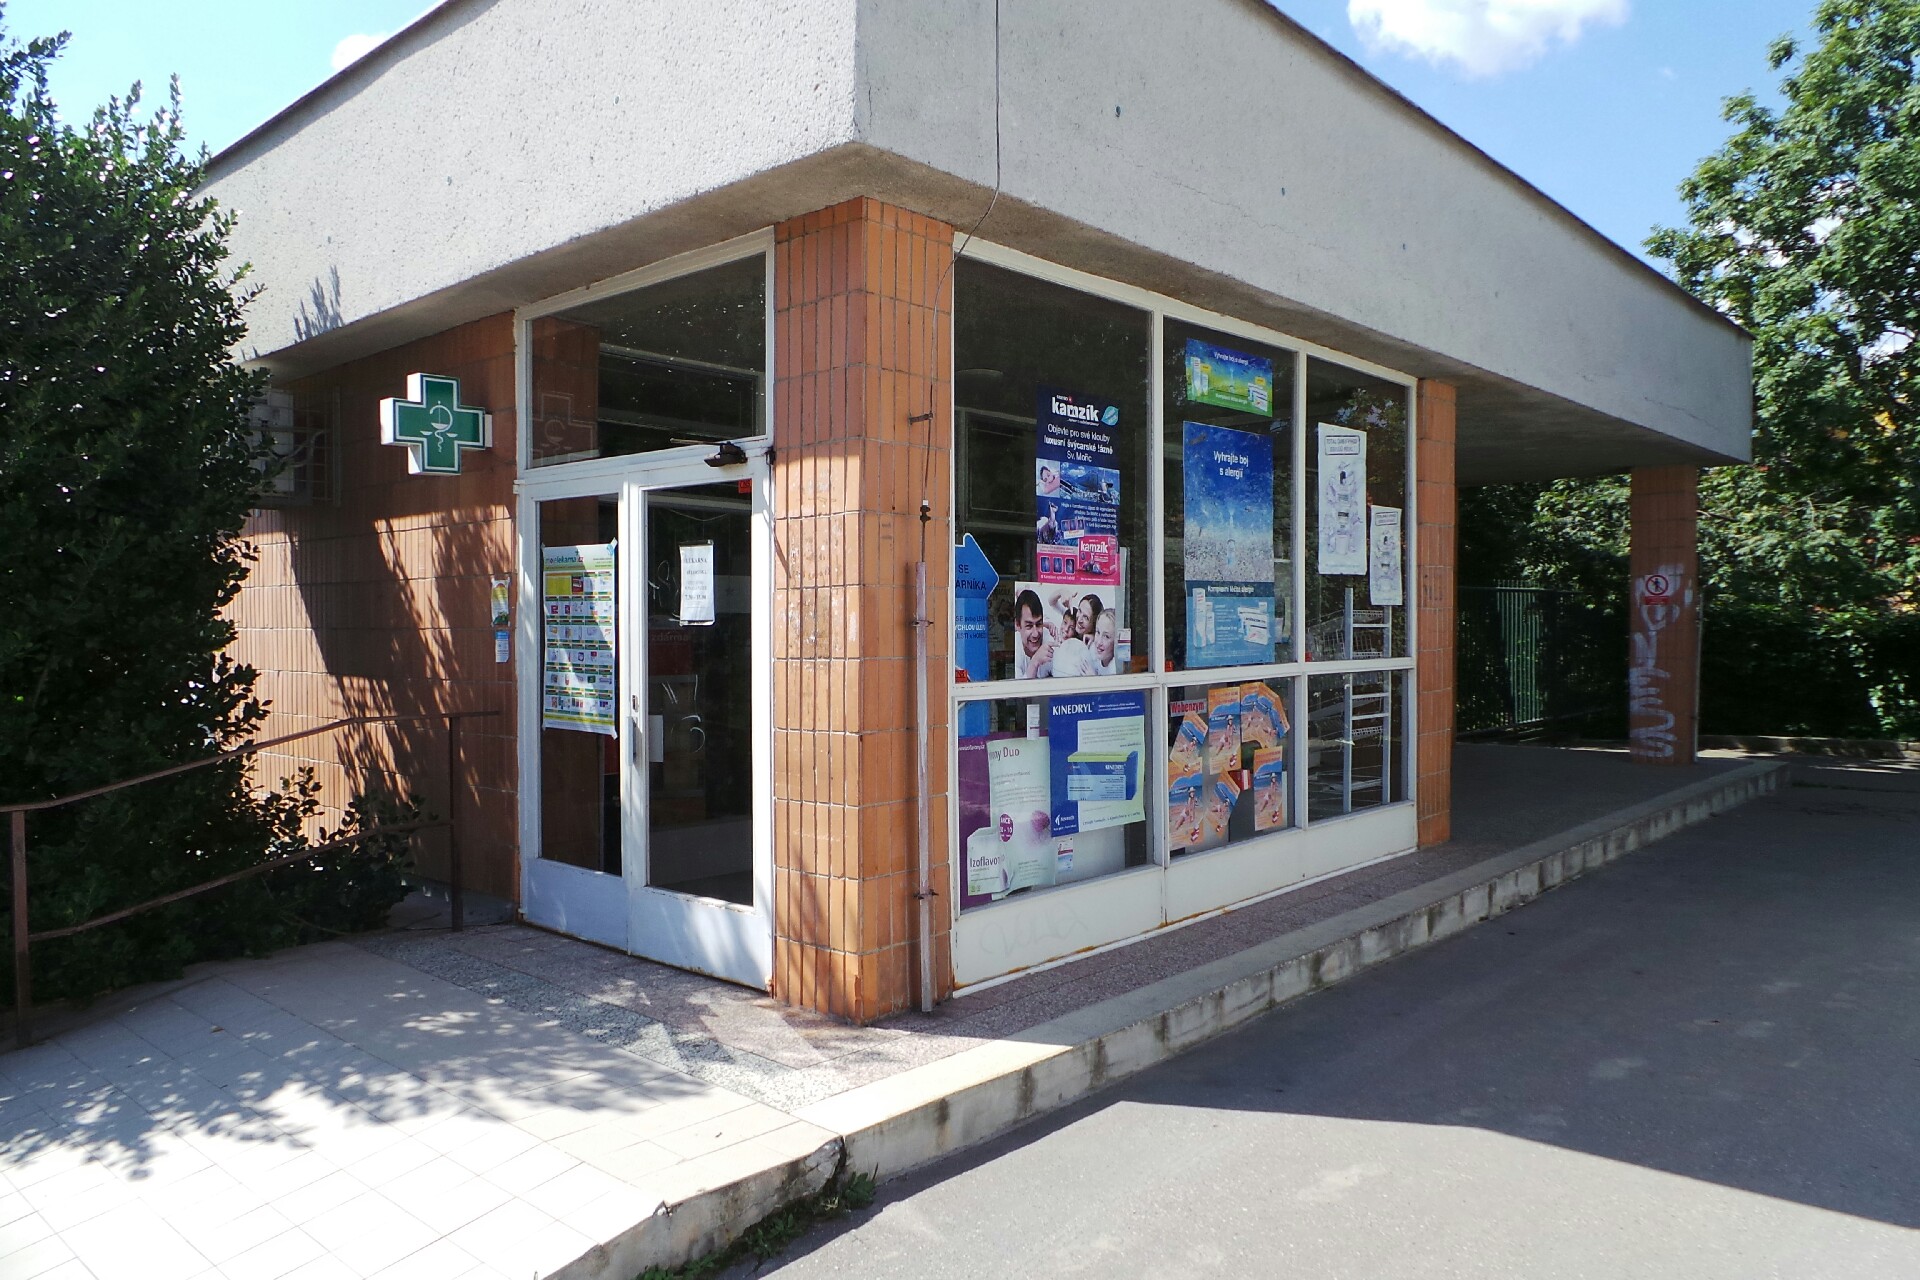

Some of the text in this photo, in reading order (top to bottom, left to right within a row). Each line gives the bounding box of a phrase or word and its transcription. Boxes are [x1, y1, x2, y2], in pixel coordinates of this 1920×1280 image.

[1051, 396, 1099, 422] kamzík
[1047, 423, 1111, 444] Objevte pro své klouby
[1043, 434, 1114, 455] luxusní švýcarské lázně
[1066, 450, 1093, 463] Sv. Mořic
[1213, 450, 1249, 467] Vyhrajte boj
[1219, 467, 1224, 476] s
[1080, 540, 1109, 554] kamzík
[958, 563, 970, 574] SE
[1171, 701, 1205, 713] Wobenzym
[1003, 746, 1020, 758] Duo
